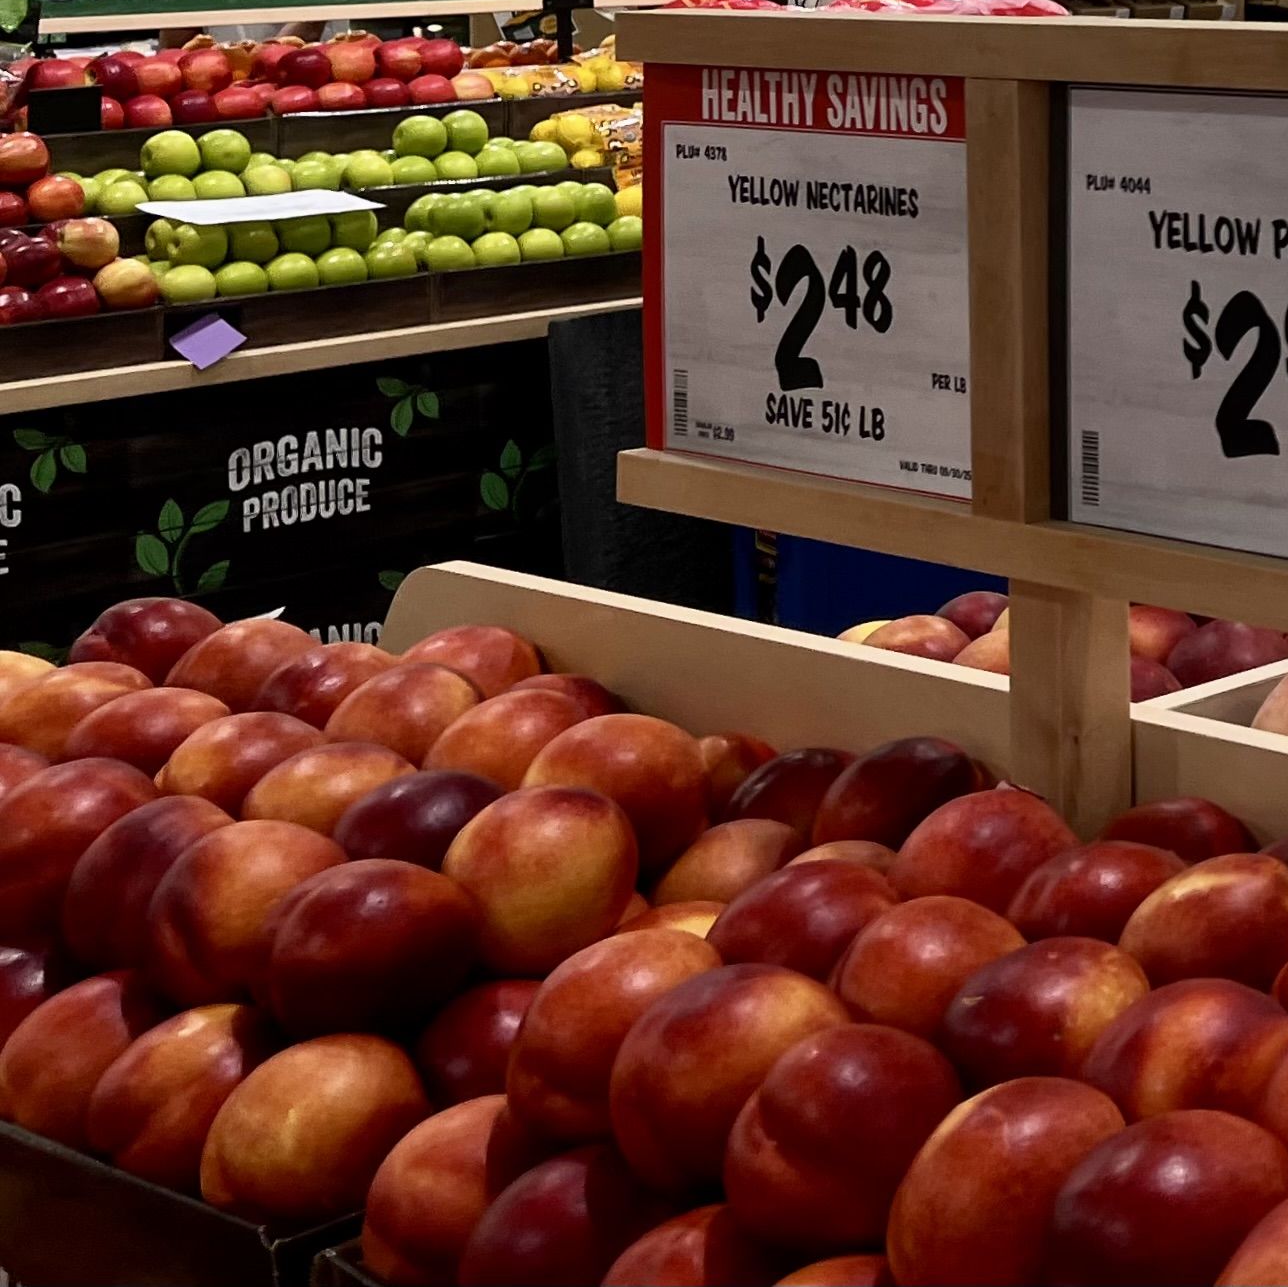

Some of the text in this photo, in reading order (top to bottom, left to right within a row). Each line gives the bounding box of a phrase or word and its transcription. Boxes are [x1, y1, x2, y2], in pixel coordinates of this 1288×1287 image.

[701, 68, 949, 135] HEALTHY SAVINGS
[675, 144, 701, 160] PLU#
[727, 174, 920, 219] YELLOW NECTARINES
[1085, 174, 1152, 195] PLU# 4044
[1149, 210, 1261, 256] YELLOW
[931, 373, 967, 395] PER LB
[764, 393, 886, 441] SAVE 51¢ LB
[228, 427, 384, 492] ORGANIC
[242, 478, 372, 533] PRODUCE
